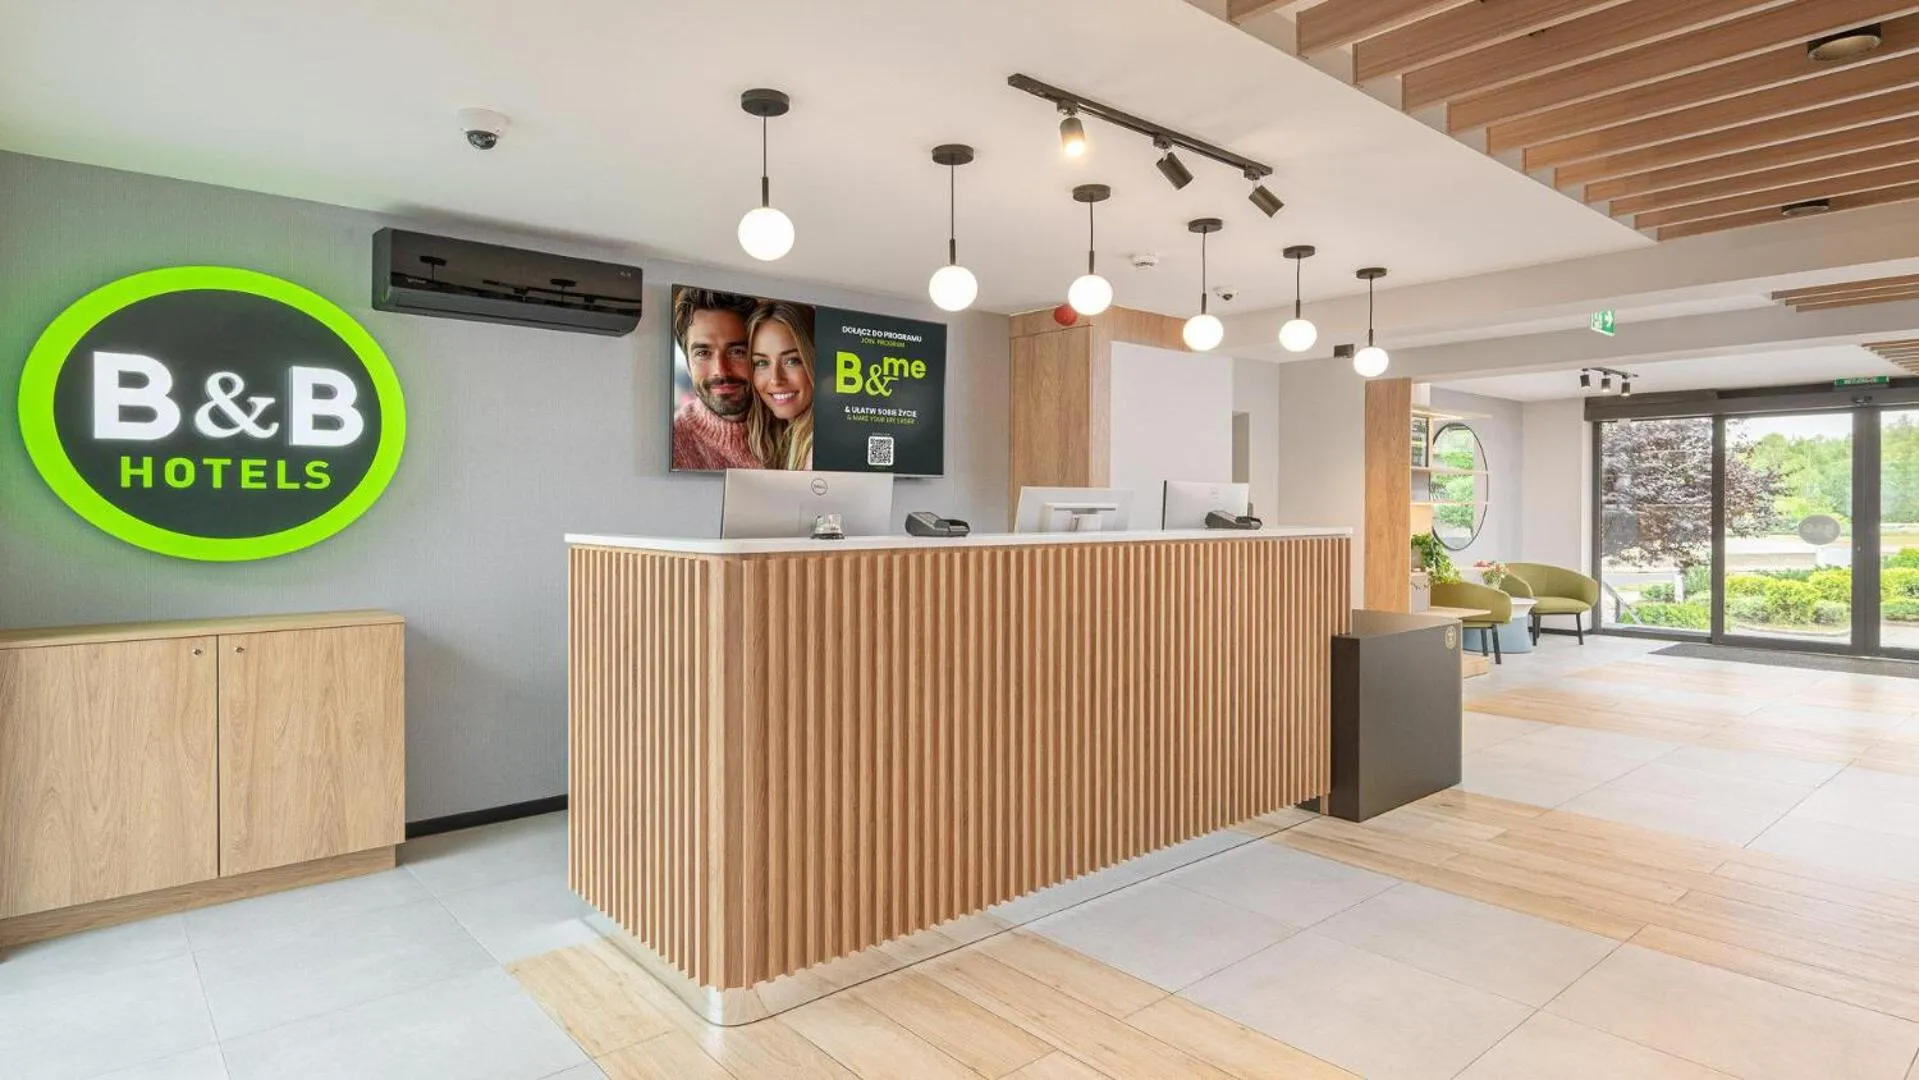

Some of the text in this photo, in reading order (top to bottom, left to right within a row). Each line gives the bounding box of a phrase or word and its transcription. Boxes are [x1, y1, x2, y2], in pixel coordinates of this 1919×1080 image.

[842, 326, 922, 342] DOŁĄCZ DO PROGRAMU
[898, 408, 917, 418] ŻYCIE
[120, 456, 331, 490] HOTELS
